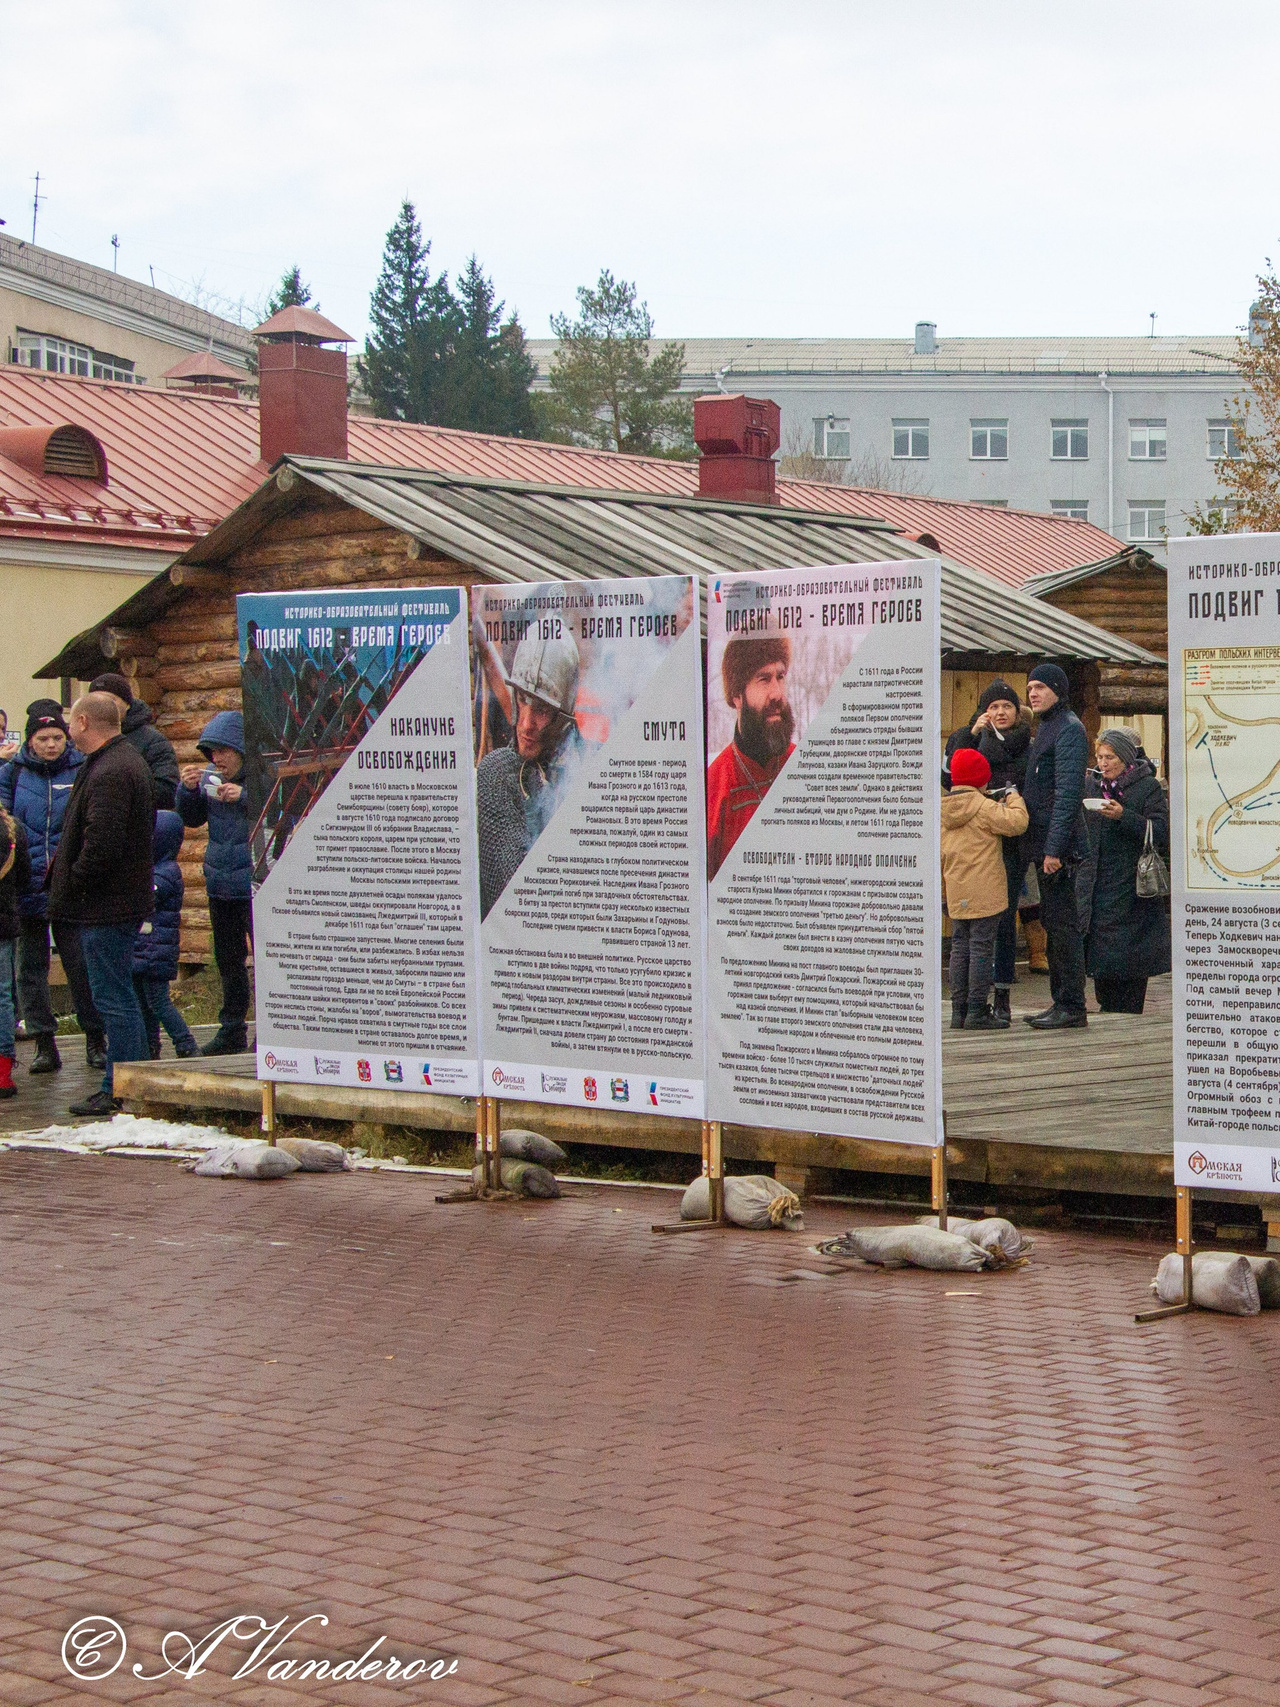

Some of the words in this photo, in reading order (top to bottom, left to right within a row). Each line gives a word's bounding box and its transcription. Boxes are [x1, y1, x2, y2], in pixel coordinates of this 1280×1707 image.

[1188, 590, 1263, 620] ПОДВИГ
[725, 607, 773, 634] ПОДВИГ
[778, 606, 802, 629] 1612
[822, 602, 864, 626] ВРЕМЯ
[871, 598, 921, 623] ГЕРОЕВ
[256, 628, 301, 651] ПОДВИГ
[308, 627, 333, 647] 1612
[352, 625, 394, 646] ВРЕМЯ
[401, 623, 451, 647] ГЕРОЕВ
[486, 620, 531, 645] ПОДВИГ
[537, 618, 562, 640] 1612
[581, 616, 622, 639] ВРЕМЯ
[629, 614, 678, 637] ГЕРОЕВ
[390, 717, 454, 736] НАКАНУНЕ
[643, 721, 685, 740] СМУТА
[357, 750, 456, 771] ОСВОБОЖДЕНИЯ
[1184, 903, 1229, 914] Сражение
[1184, 918, 1208, 928] день,
[1211, 917, 1222, 926] 24
[1224, 919, 1258, 929] августа
[1260, 918, 1270, 929] (3
[1187, 1117, 1249, 1130] Китай-городе
